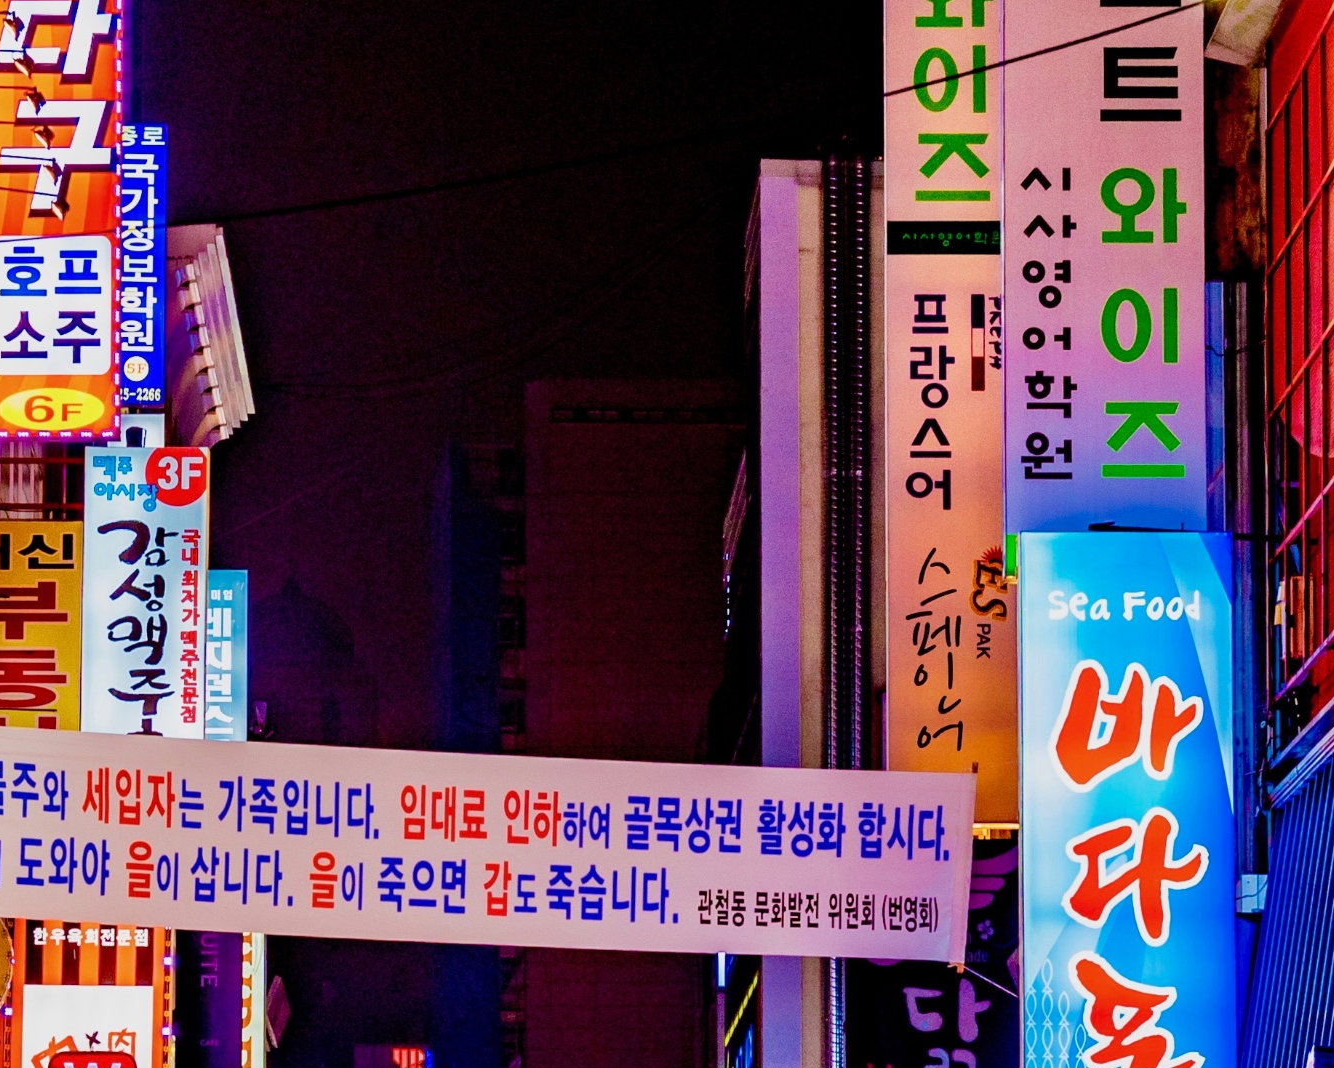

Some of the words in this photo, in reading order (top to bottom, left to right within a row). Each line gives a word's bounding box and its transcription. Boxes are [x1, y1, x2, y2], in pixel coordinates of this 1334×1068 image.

[0, 246, 101, 297] 호프
[121, 154, 159, 353] 국가정보학원
[0, 311, 101, 364] 소주
[1020, 167, 1078, 480] 시사영어학원
[1100, 168, 1187, 478] 와이즈
[126, 361, 147, 375] 5F
[23, 395, 84, 422] 6F
[905, 295, 955, 511] 프랑스어
[93, 455, 132, 482] 맥주
[157, 456, 203, 491] 3F
[93, 482, 159, 512] 야시장
[1048, 590, 1109, 621] Sea
[1123, 590, 1200, 621] Food
[906, 547, 963, 752] 스페인어
[82, 768, 205, 829] 세입자는
[218, 775, 380, 839] 가족입니다.
[400, 784, 488, 843] 임대료
[503, 789, 610, 851] 인하하여
[624, 795, 743, 855] 골목상권
[757, 799, 847, 858] 활성화
[858, 803, 951, 862] 합시다.
[16, 836, 111, 896] 도와야
[125, 840, 180, 899] 을이
[190, 846, 294, 906] 삽니다.
[309, 850, 365, 910] 을이
[377, 856, 467, 915] 죽으면
[697, 888, 746, 928] 관철동
[754, 891, 820, 929] 문화발전
[827, 892, 877, 931] 위원회
[881, 894, 939, 934] (번영회)
